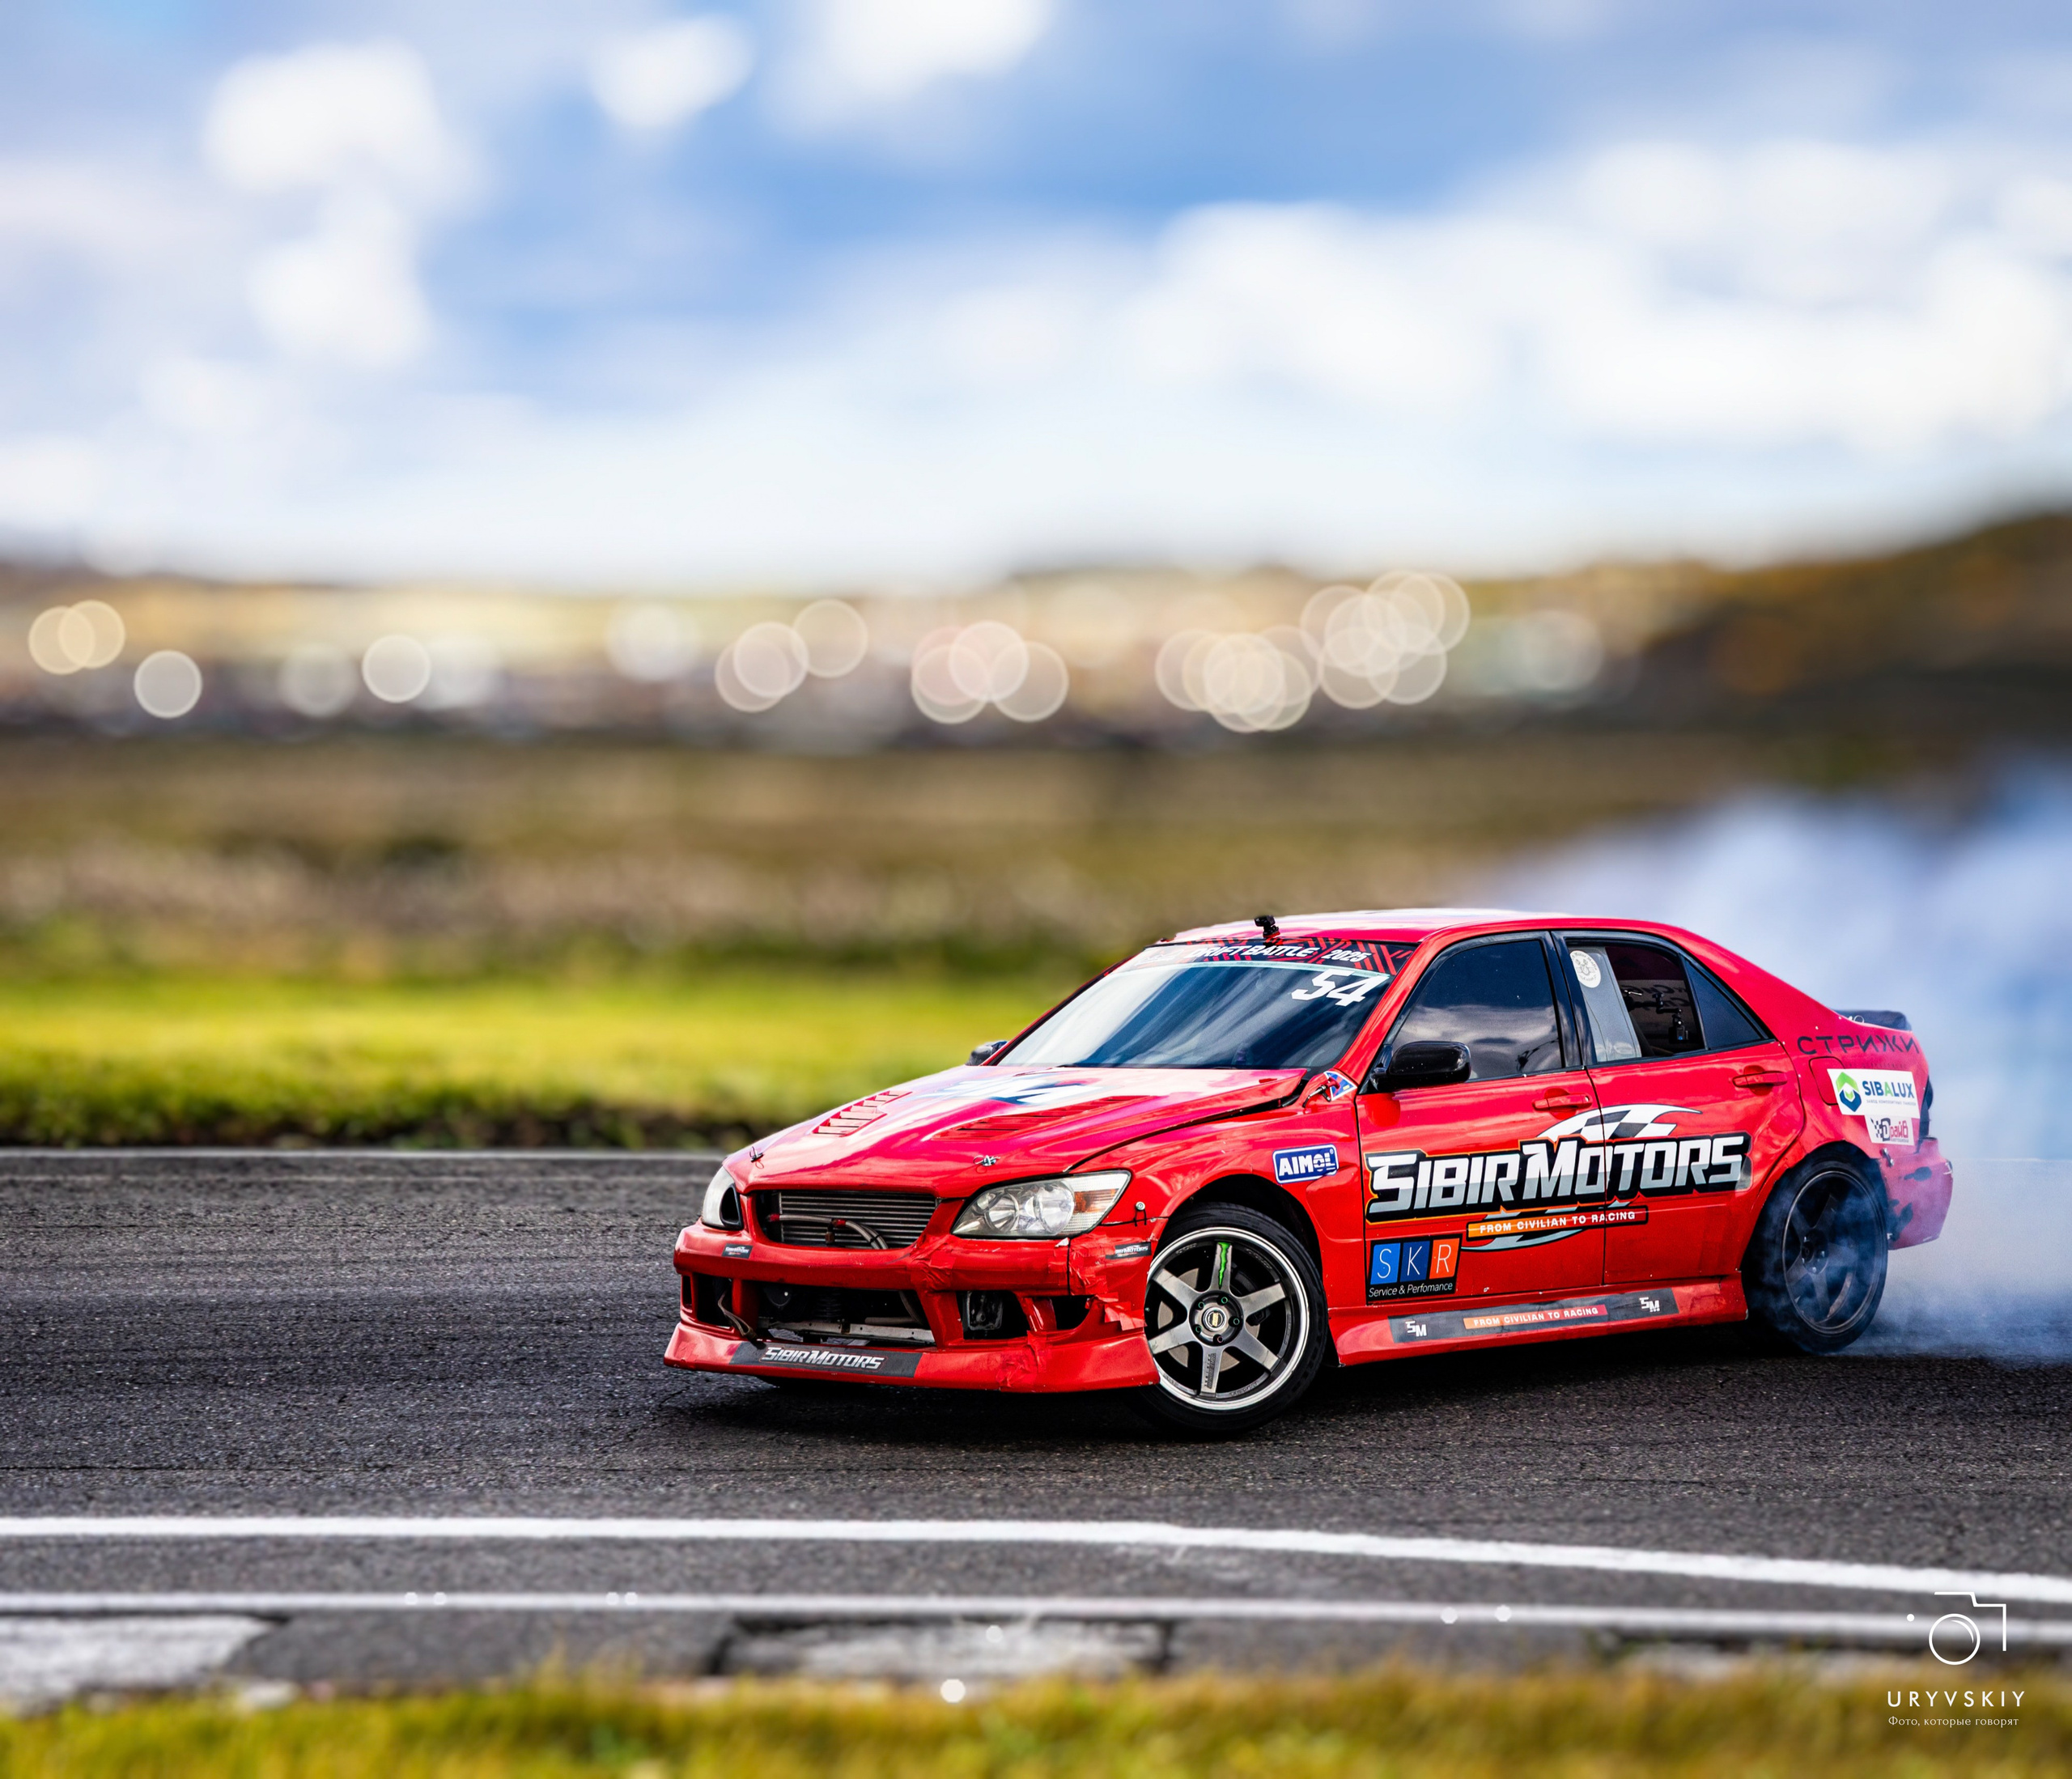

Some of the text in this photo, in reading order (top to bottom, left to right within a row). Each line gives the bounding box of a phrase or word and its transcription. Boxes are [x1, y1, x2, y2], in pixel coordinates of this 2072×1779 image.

[1240, 945, 1320, 957] BATTLE
[1321, 949, 1372, 962] 2025
[1291, 968, 1390, 1007] 54
[1797, 1034, 1920, 1055] СТРИЖИ
[1862, 1081, 1915, 1099] SIBALUX
[1279, 1152, 1336, 1176] AIMOL
[1480, 1210, 1636, 1234] FROM CIVILIAN TO RACING
[1377, 1244, 1452, 1279] SKR
[1369, 1282, 1454, 1297] Service & Perfomance
[1473, 1306, 1599, 1327] FROM CIVILIAN TO RACING
[1404, 1319, 1428, 1337] SM
